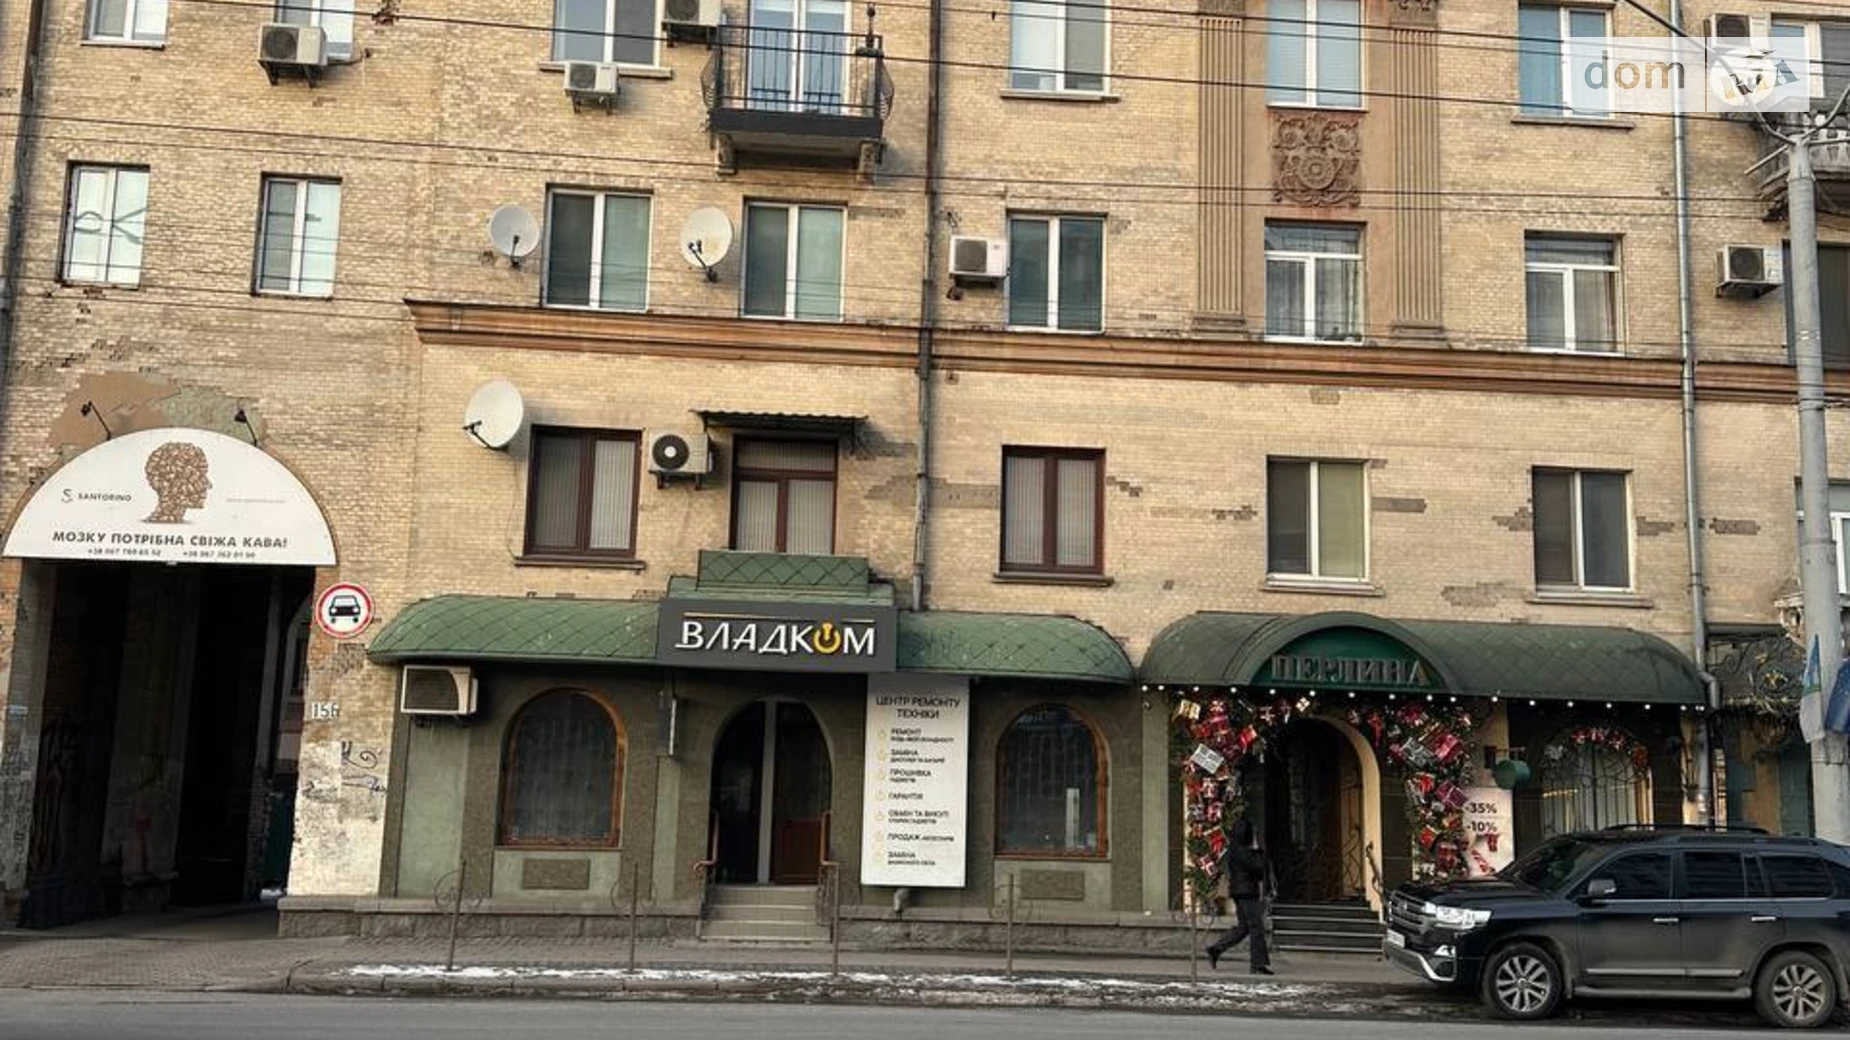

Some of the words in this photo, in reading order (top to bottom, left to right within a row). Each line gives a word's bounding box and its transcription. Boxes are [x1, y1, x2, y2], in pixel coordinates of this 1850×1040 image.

[78, 492, 132, 502] SANTORINO
[52, 531, 107, 543] МОЗКУ
[111, 533, 184, 546] ПОТРІБНА
[190, 535, 236, 547] СВІЖА
[242, 537, 288, 549] КАВА!
[675, 620, 875, 656] ВЛАДКОМ
[1271, 653, 1431, 686] ПЕРЛИНА
[876, 696, 910, 706] ЦЕНТР
[911, 697, 960, 707] РЕМОНТУ
[896, 708, 940, 719] ТЕХНІКИ
[891, 728, 922, 736] РЕМОНТ
[890, 768, 931, 777] ПРОШИВКА
[888, 792, 923, 800] ГАРАНТІЯ
[1464, 802, 1498, 814] -35%
[914, 810, 923, 818] ТА
[1466, 820, 1498, 833] -10%
[887, 833, 920, 842] ПРОДАЖ
